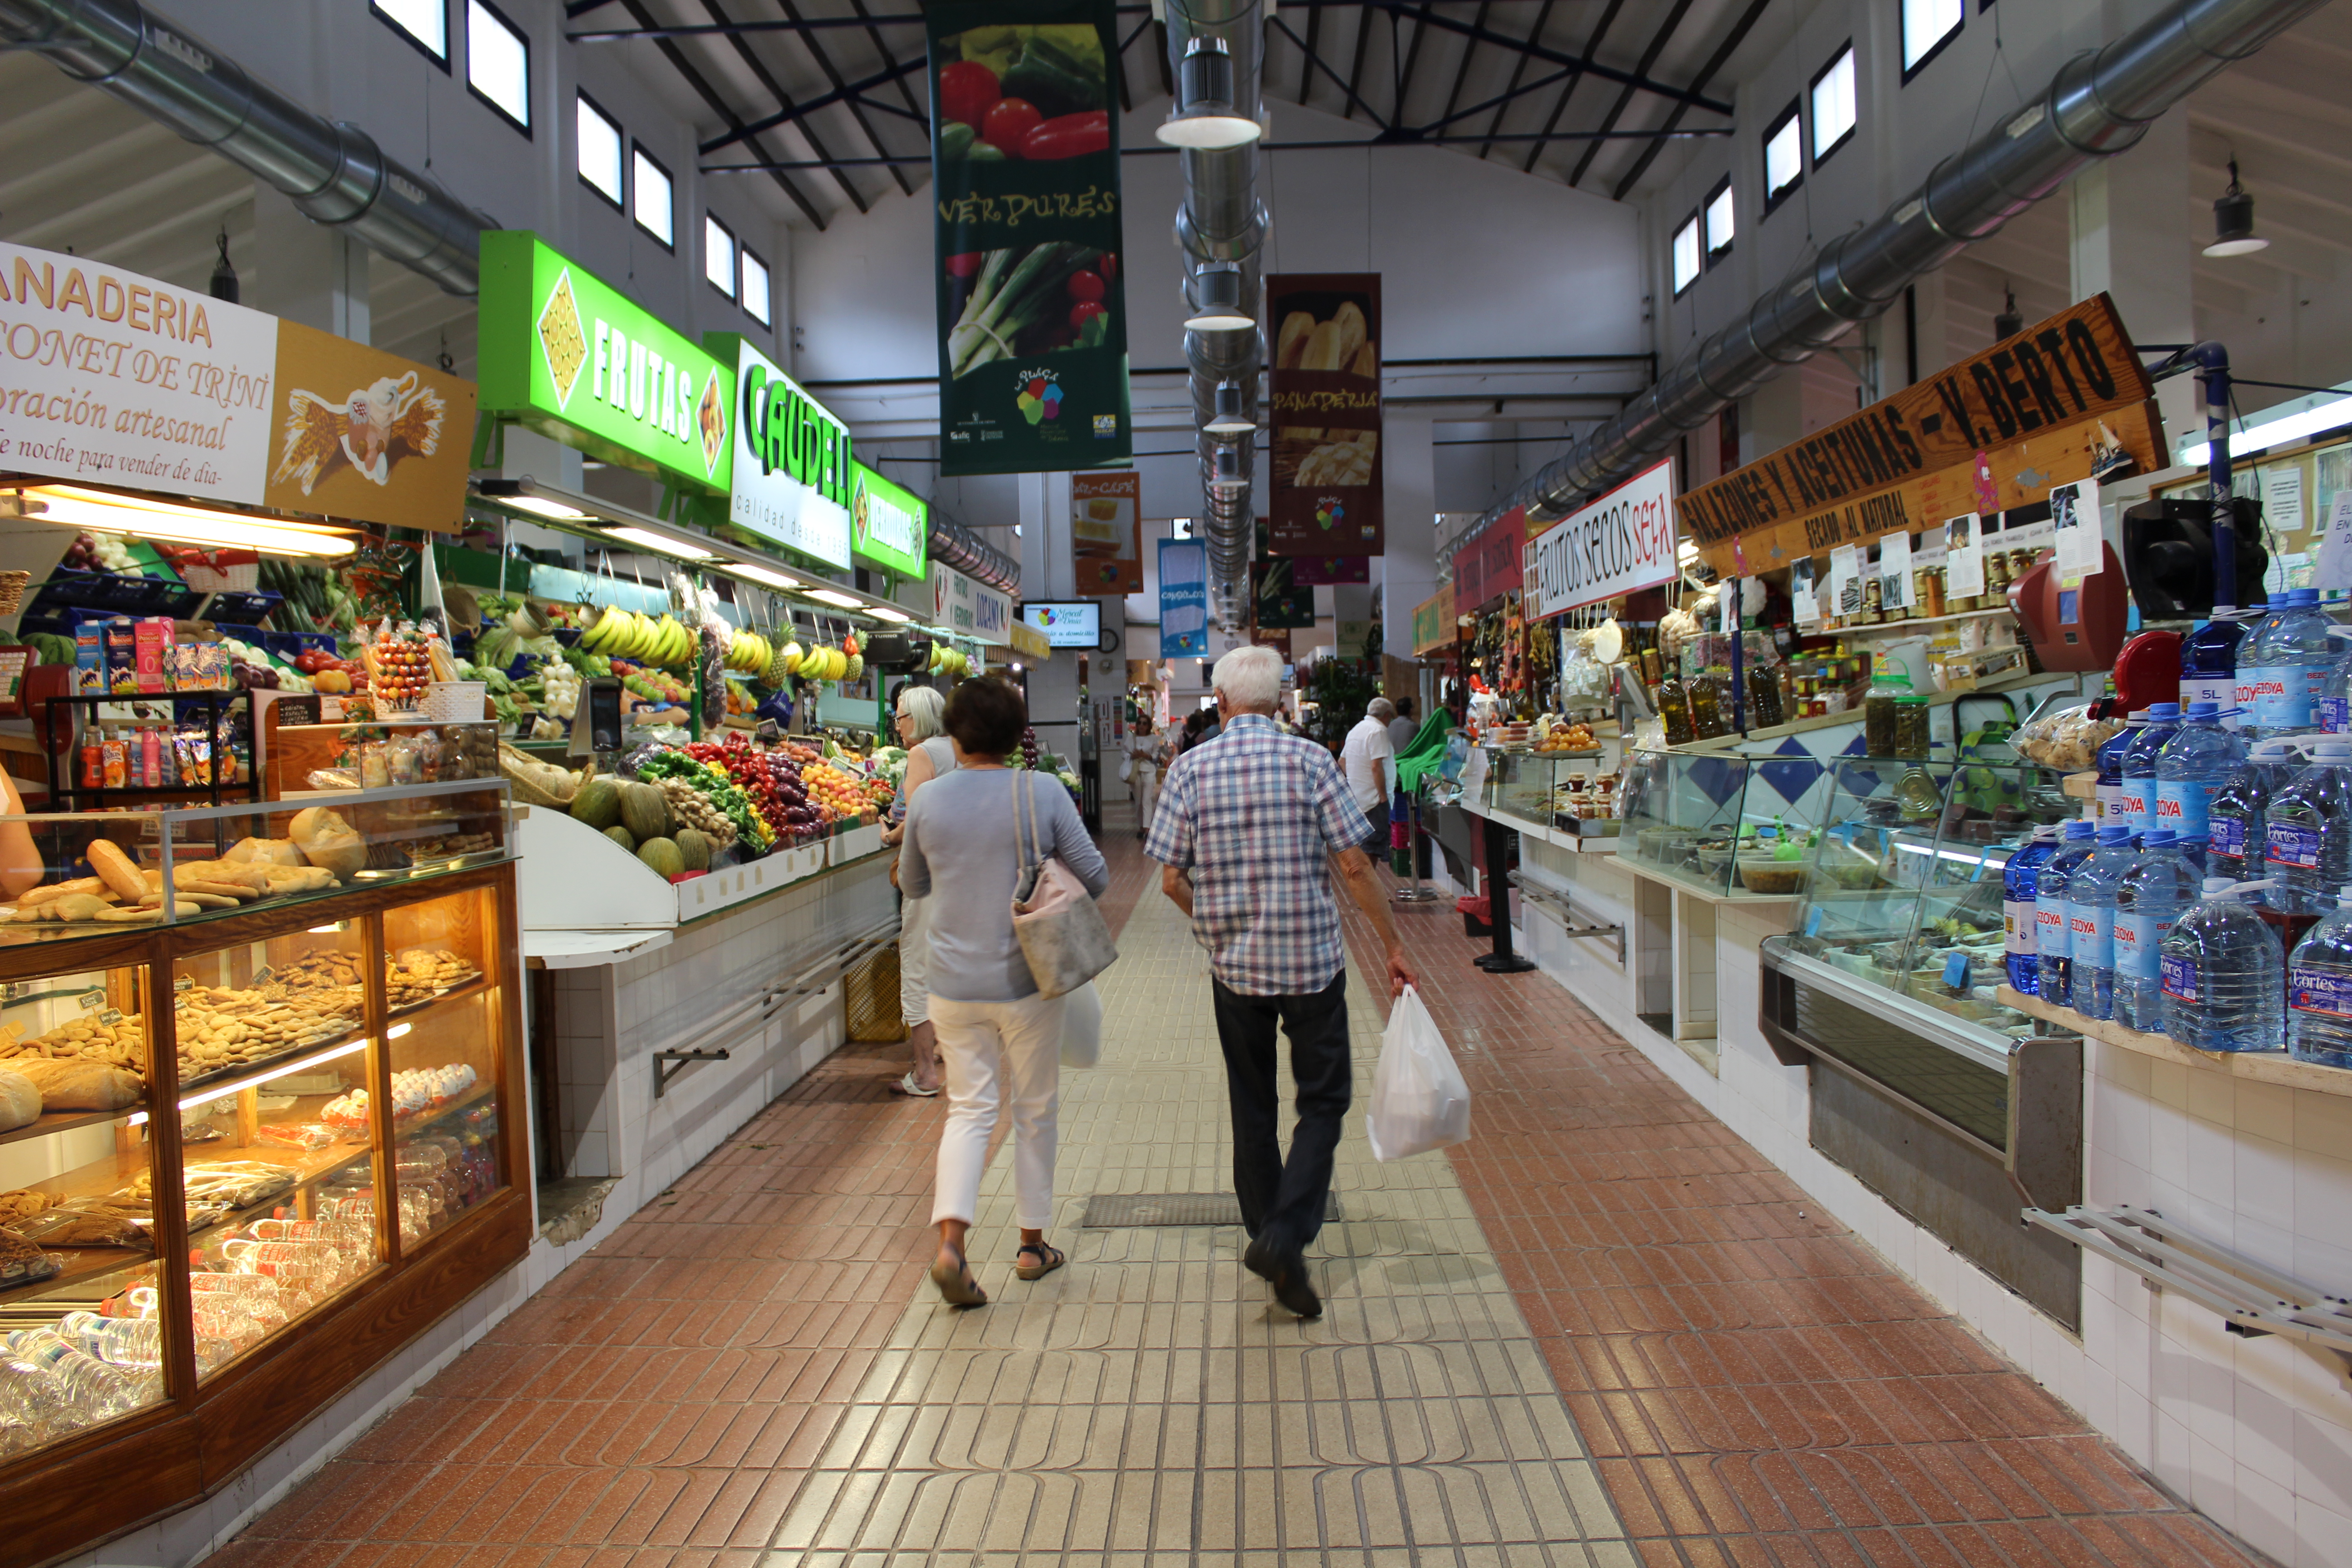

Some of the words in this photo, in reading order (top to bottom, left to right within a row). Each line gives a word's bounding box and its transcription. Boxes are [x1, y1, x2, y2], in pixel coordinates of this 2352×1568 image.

[0, 256, 212, 348] NADERIA
[133, 350, 181, 390] DE
[593, 317, 692, 444] FRUTAS
[114, 407, 232, 450] artesanal
[18, 437, 74, 463] noche
[76, 449, 113, 473] para
[118, 453, 171, 478] vender
[172, 458, 191, 480] de
[1681, 469, 1779, 544] SALAZONES
[1764, 460, 1797, 514] Y
[1785, 404, 1923, 508] ACEITUNAS
[736, 495, 784, 529] Calidad
[791, 517, 820, 546] desde
[828, 534, 847, 559] 1955
[869, 492, 912, 557] VERDURAS
[1805, 511, 1842, 549] SECADO
[1845, 505, 1861, 539] AL
[1860, 490, 1909, 534] NATURAL
[2335, 519, 2349, 530] EN
[1539, 527, 1581, 609] FRUTOS
[1584, 500, 1632, 585] SECOS
[1634, 493, 1672, 568] SEFA
[954, 573, 968, 599] FRUTAS
[949, 602, 952, 624] Y
[954, 604, 973, 631] VERDURAS
[976, 592, 998, 633] LOZANO
[1056, 608, 1083, 617] Mercat
[2202, 690, 2222, 699] 5L
[104, 746, 111, 755] Bi
[2268, 822, 2300, 844] Cortes
[2293, 968, 2336, 992] Cortes
